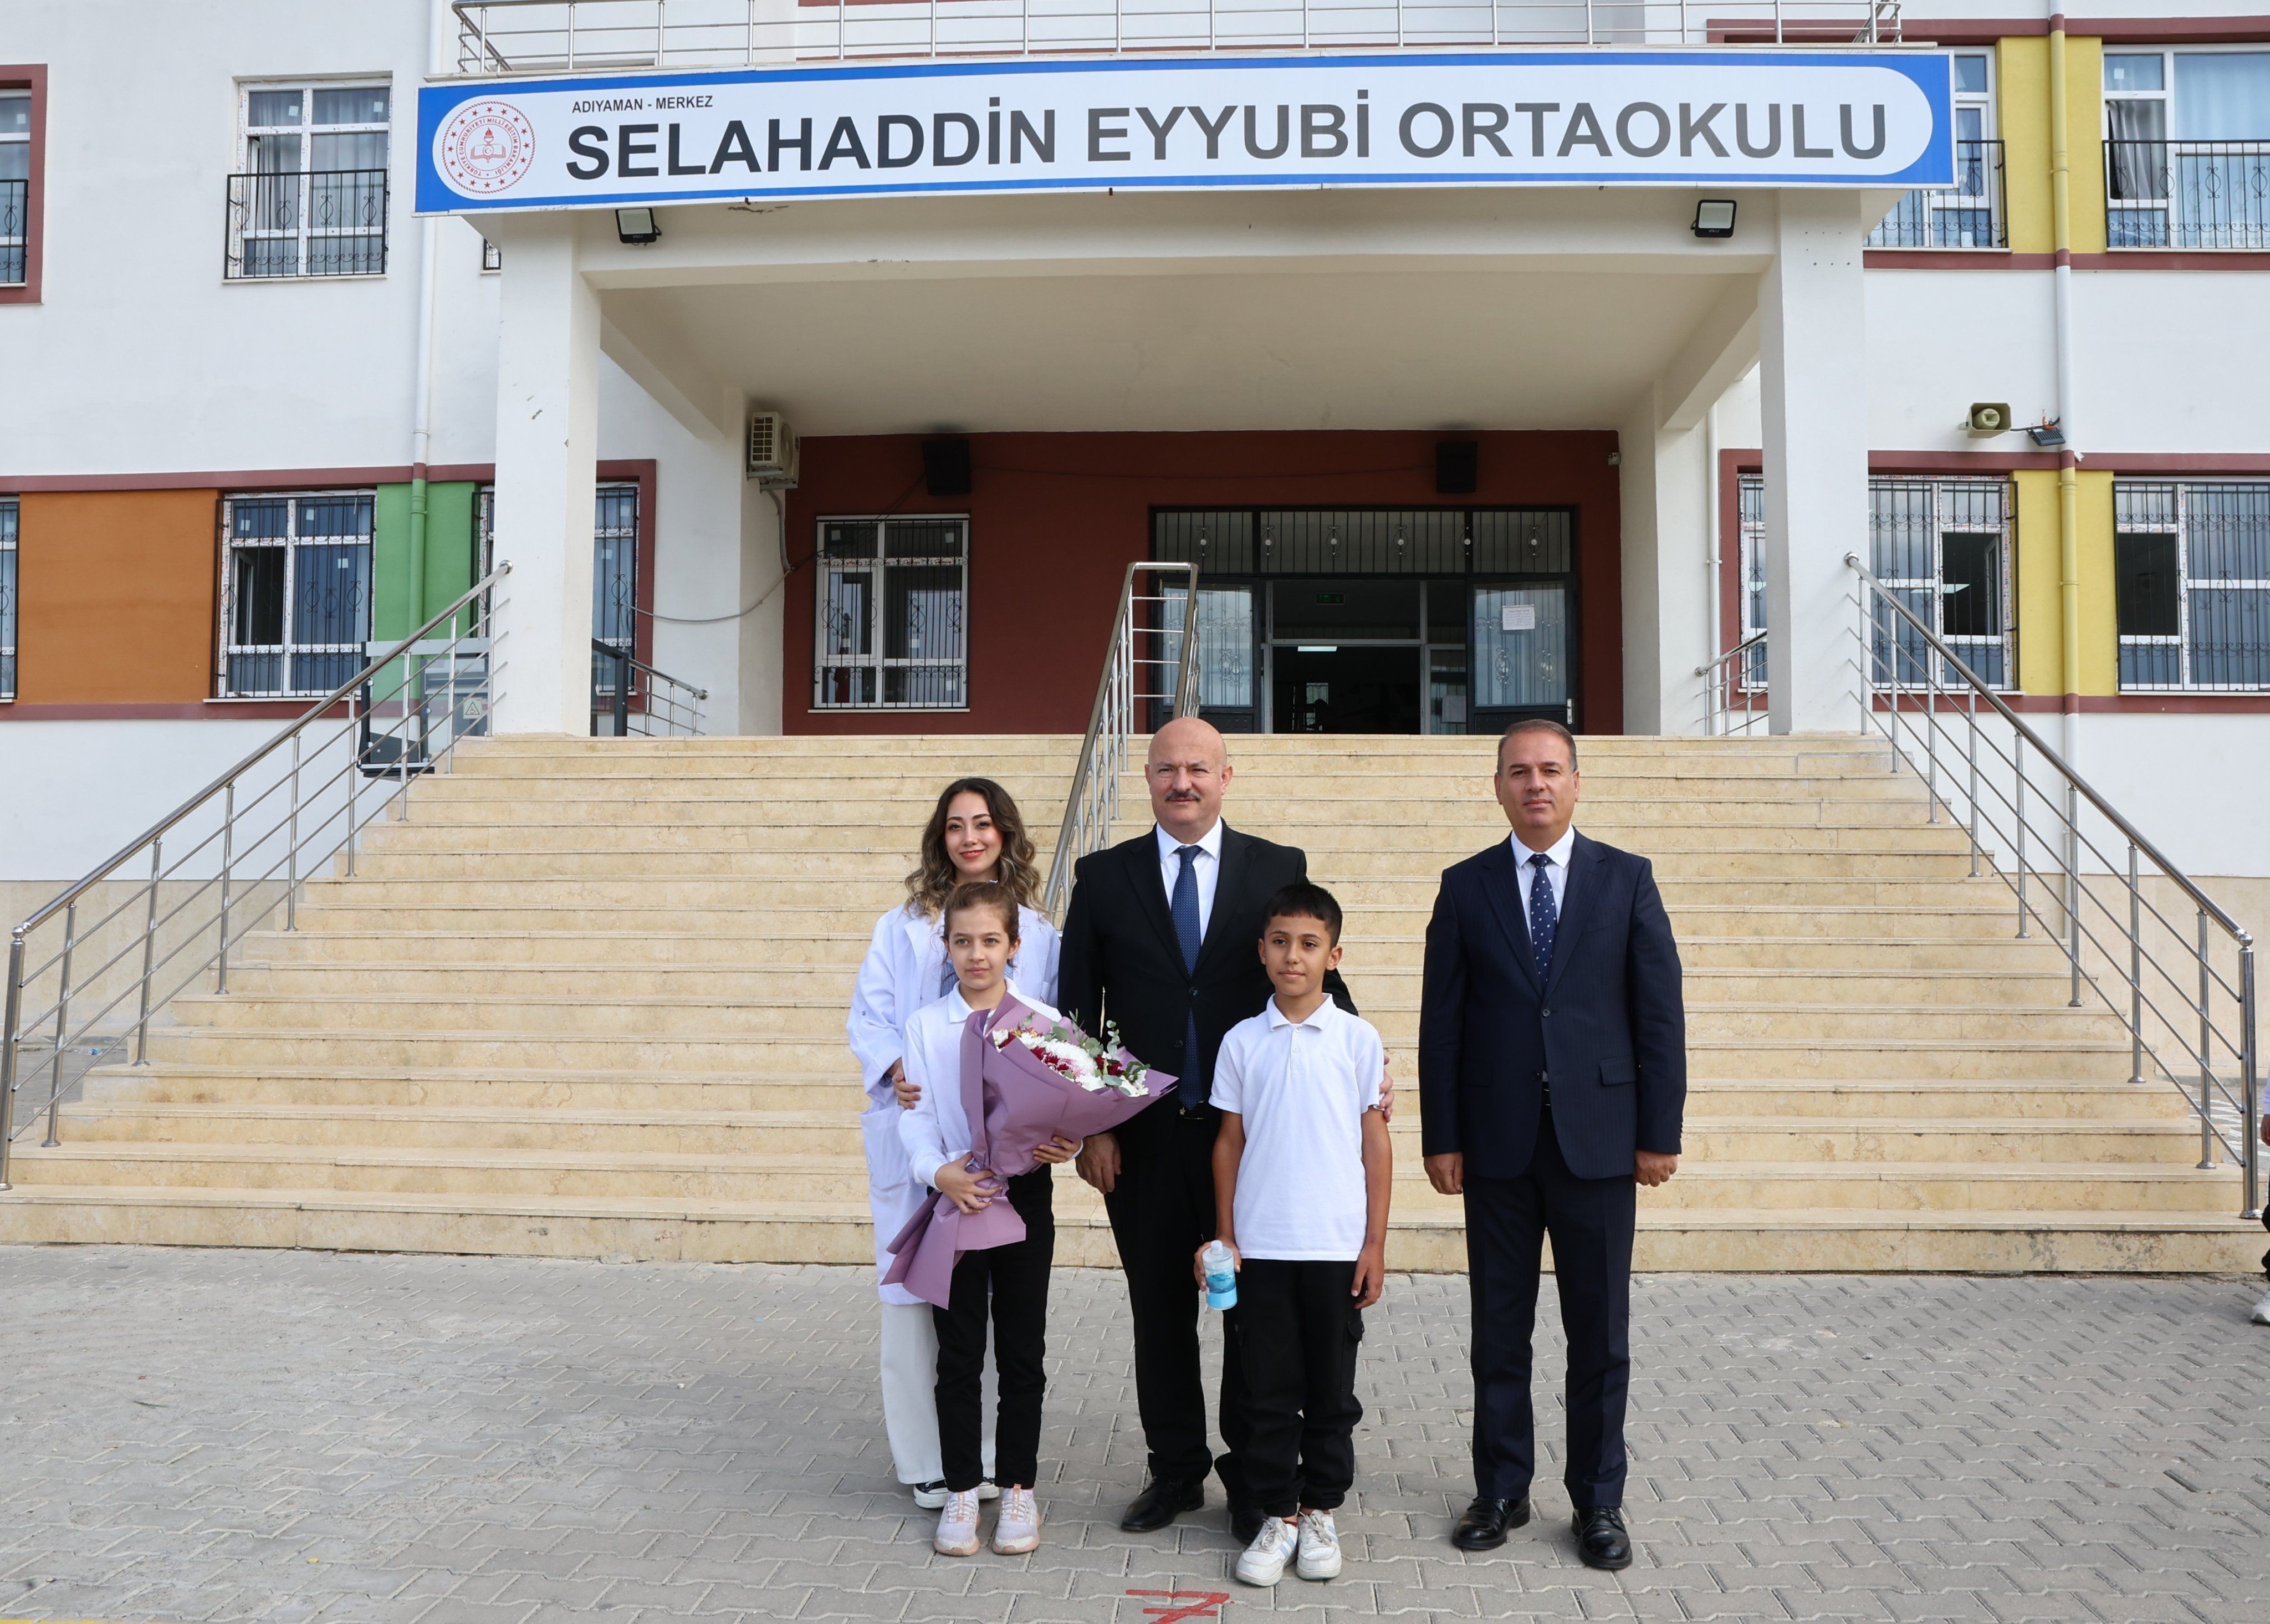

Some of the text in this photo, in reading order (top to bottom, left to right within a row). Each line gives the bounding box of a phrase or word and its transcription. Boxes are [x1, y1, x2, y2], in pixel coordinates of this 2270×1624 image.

[572, 99, 643, 113] ADIYAMAN
[656, 96, 713, 109] MERKEZ
[459, 119, 485, 155] CUMHURİYETİ
[505, 124, 518, 144] EĞİTİM
[566, 90, 1885, 180] SELAHADDİN EYYUBİ ORTAOKULU
[460, 156, 481, 176] TÜRKİYE
[495, 146, 518, 175] BAKANLIĞI
